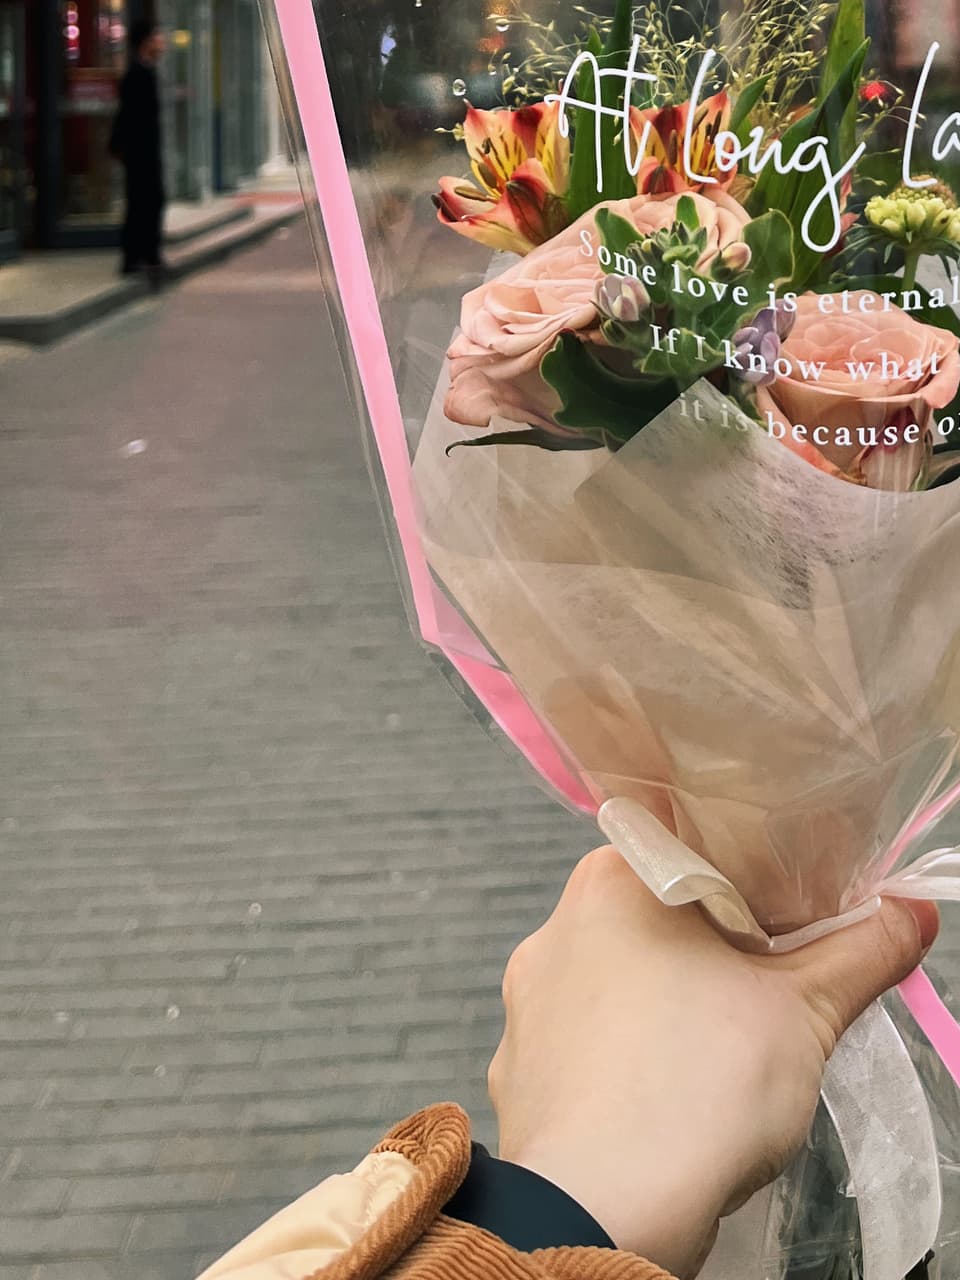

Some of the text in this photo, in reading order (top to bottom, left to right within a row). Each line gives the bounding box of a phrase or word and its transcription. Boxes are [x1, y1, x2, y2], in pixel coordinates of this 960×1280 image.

[545, 34, 658, 193] At
[684, 49, 865, 253] Long
[579, 229, 657, 286] Some
[671, 263, 749, 307] love
[766, 283, 798, 313] is
[817, 275, 960, 315] eternal
[650, 324, 680, 354] If
[694, 333, 708, 362] I
[723, 339, 828, 382] know
[846, 351, 941, 382] what
[679, 392, 705, 423] it
[719, 404, 750, 433] is
[765, 411, 921, 447] because
